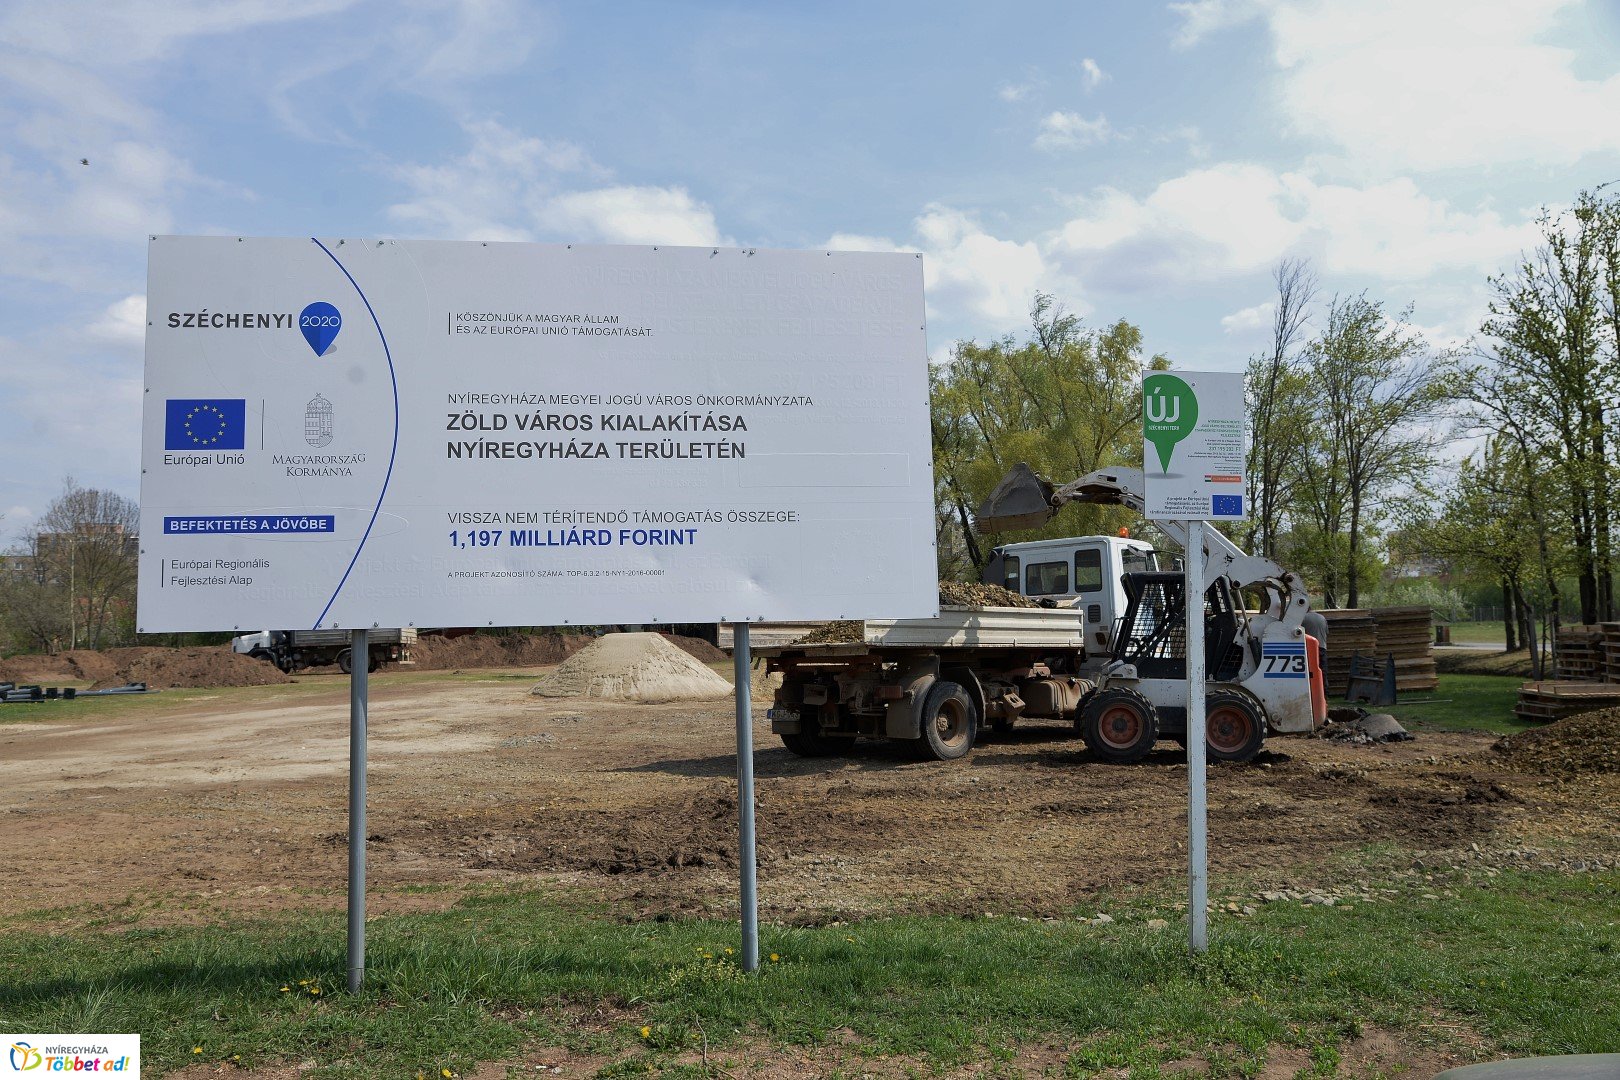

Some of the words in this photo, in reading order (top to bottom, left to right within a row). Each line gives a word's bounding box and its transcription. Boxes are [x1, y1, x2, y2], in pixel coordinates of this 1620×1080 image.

[168, 309, 292, 328] SZÉCHENYI
[302, 316, 340, 326] 2020
[457, 312, 522, 321] KÖSZÖNJÜK
[525, 314, 533, 322] A
[535, 314, 581, 323] MAGYAR
[584, 314, 618, 323] ÁLLAM
[457, 324, 470, 333] ÉS
[473, 326, 487, 334] AZ
[491, 325, 537, 334] EURÓPAI
[542, 326, 568, 335] UNIÓ
[572, 326, 653, 336] TÁMOGATÁSÁT.
[449, 392, 546, 404] NYÍREGYHÁZA
[550, 394, 601, 404] MEGYEI
[606, 393, 641, 405] JOGÚ
[647, 394, 692, 405] VÁROS
[697, 394, 813, 405] ÖNKORMÁNYZATA
[1147, 387, 1179, 422] ÚJ
[447, 410, 507, 430] ZÖLD
[515, 410, 593, 431] VÁROS
[601, 411, 747, 431] KIALAKÍTÁSA
[448, 438, 610, 459] NYÍREGYHÁZA
[616, 438, 745, 458] TERÜLETÉN
[164, 453, 211, 467] Európai
[217, 453, 245, 464] Unió
[273, 454, 365, 464] MAGYARORSZÁG
[287, 467, 351, 476] KORMÁNYA
[448, 513, 501, 523] VISSZA
[506, 513, 537, 523] NEM
[543, 510, 627, 523] TÉRÍTENDŐ
[633, 510, 722, 523] TÁMOGATÁS
[728, 510, 799, 523] ÖSSZEGE:
[171, 518, 257, 530] BEFEKTETÉS
[261, 520, 269, 529] A
[273, 517, 326, 529] JÖVŐBE
[450, 531, 502, 549] 1,197
[511, 527, 611, 546] MILLIÁRD
[620, 529, 697, 545] FORINT
[172, 560, 211, 570] Európai
[216, 559, 269, 570] Regionális
[172, 576, 226, 587] Fejlesztési
[229, 576, 252, 586] Alap
[1263, 656, 1305, 672] 773
